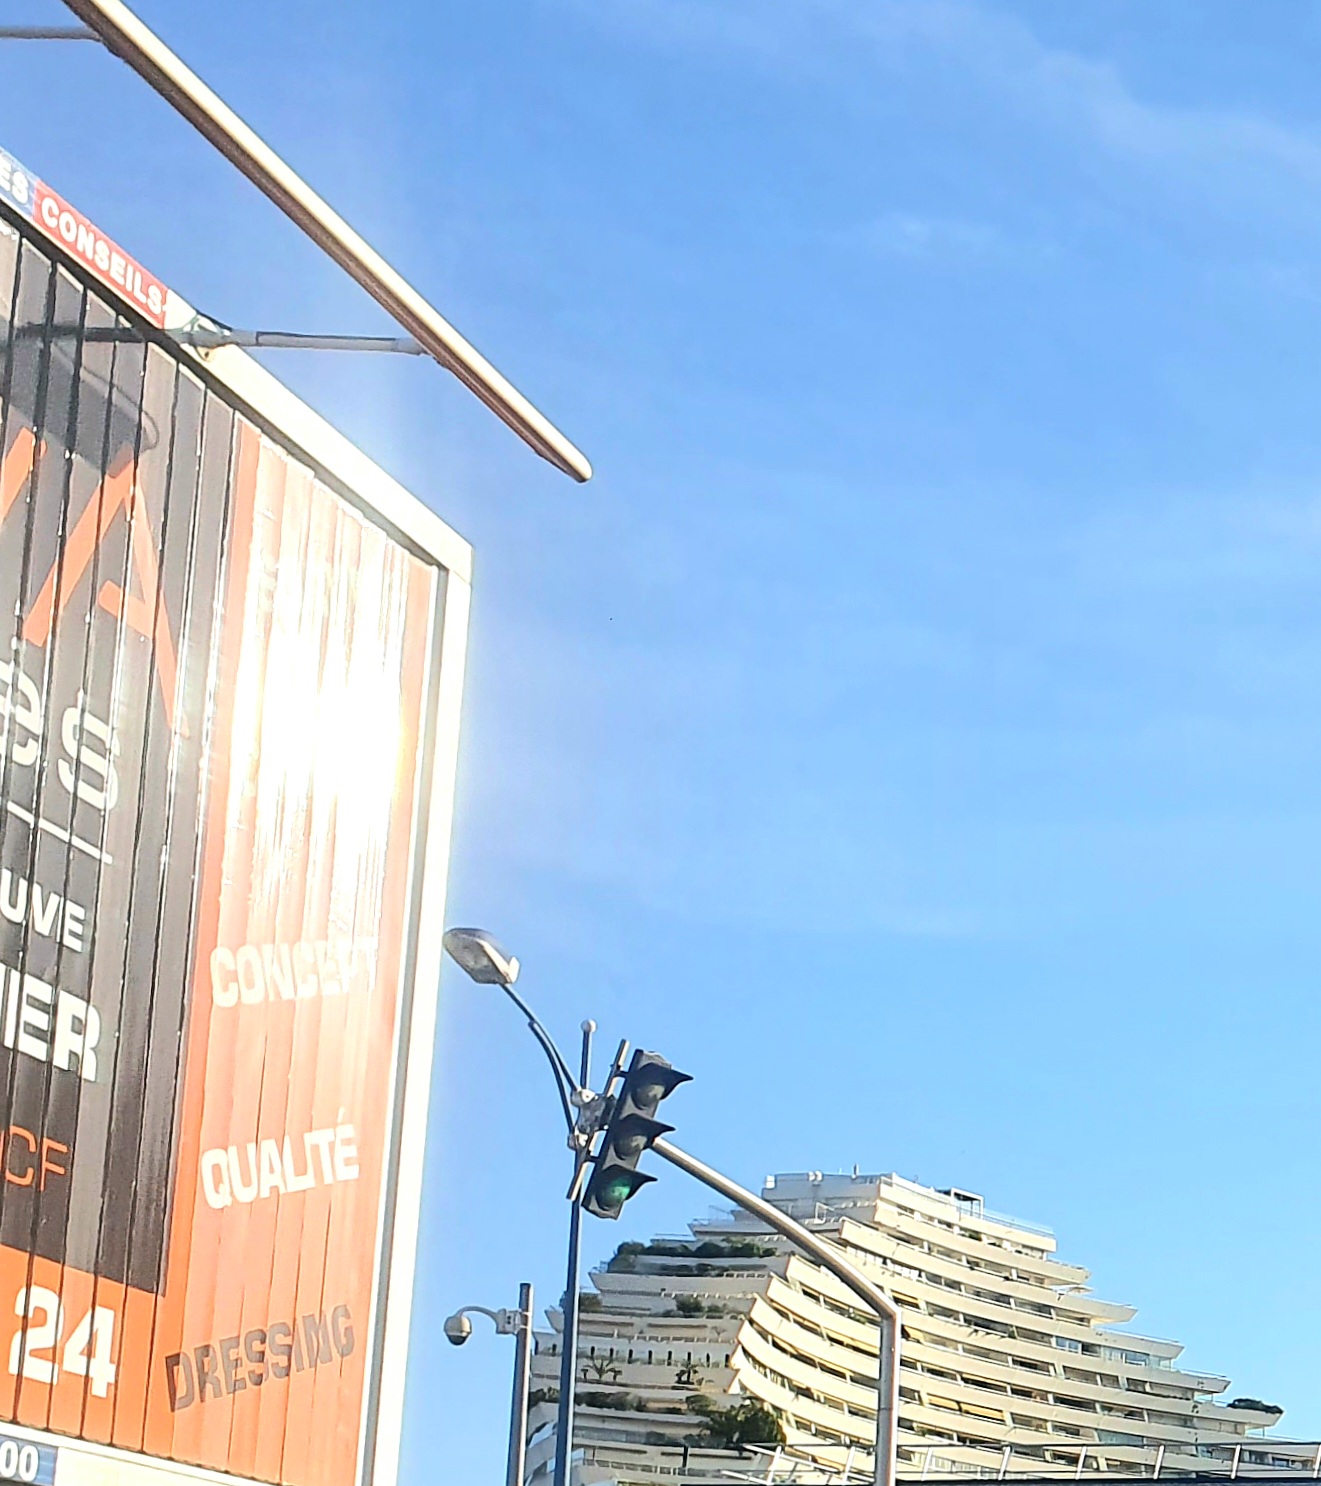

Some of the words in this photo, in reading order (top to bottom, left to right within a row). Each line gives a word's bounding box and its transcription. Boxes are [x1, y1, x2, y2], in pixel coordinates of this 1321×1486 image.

[41, 197, 163, 315] CONSEILS
[0, 867, 86, 953] UVE
[0, 962, 101, 1082] IER
[0, 1125, 68, 1192] CF
[201, 1106, 359, 1209] QUALITÉ
[8, 1284, 117, 1398] 24
[165, 1304, 355, 1413] DRESSING
[0, 1440, 39, 1482] 00
